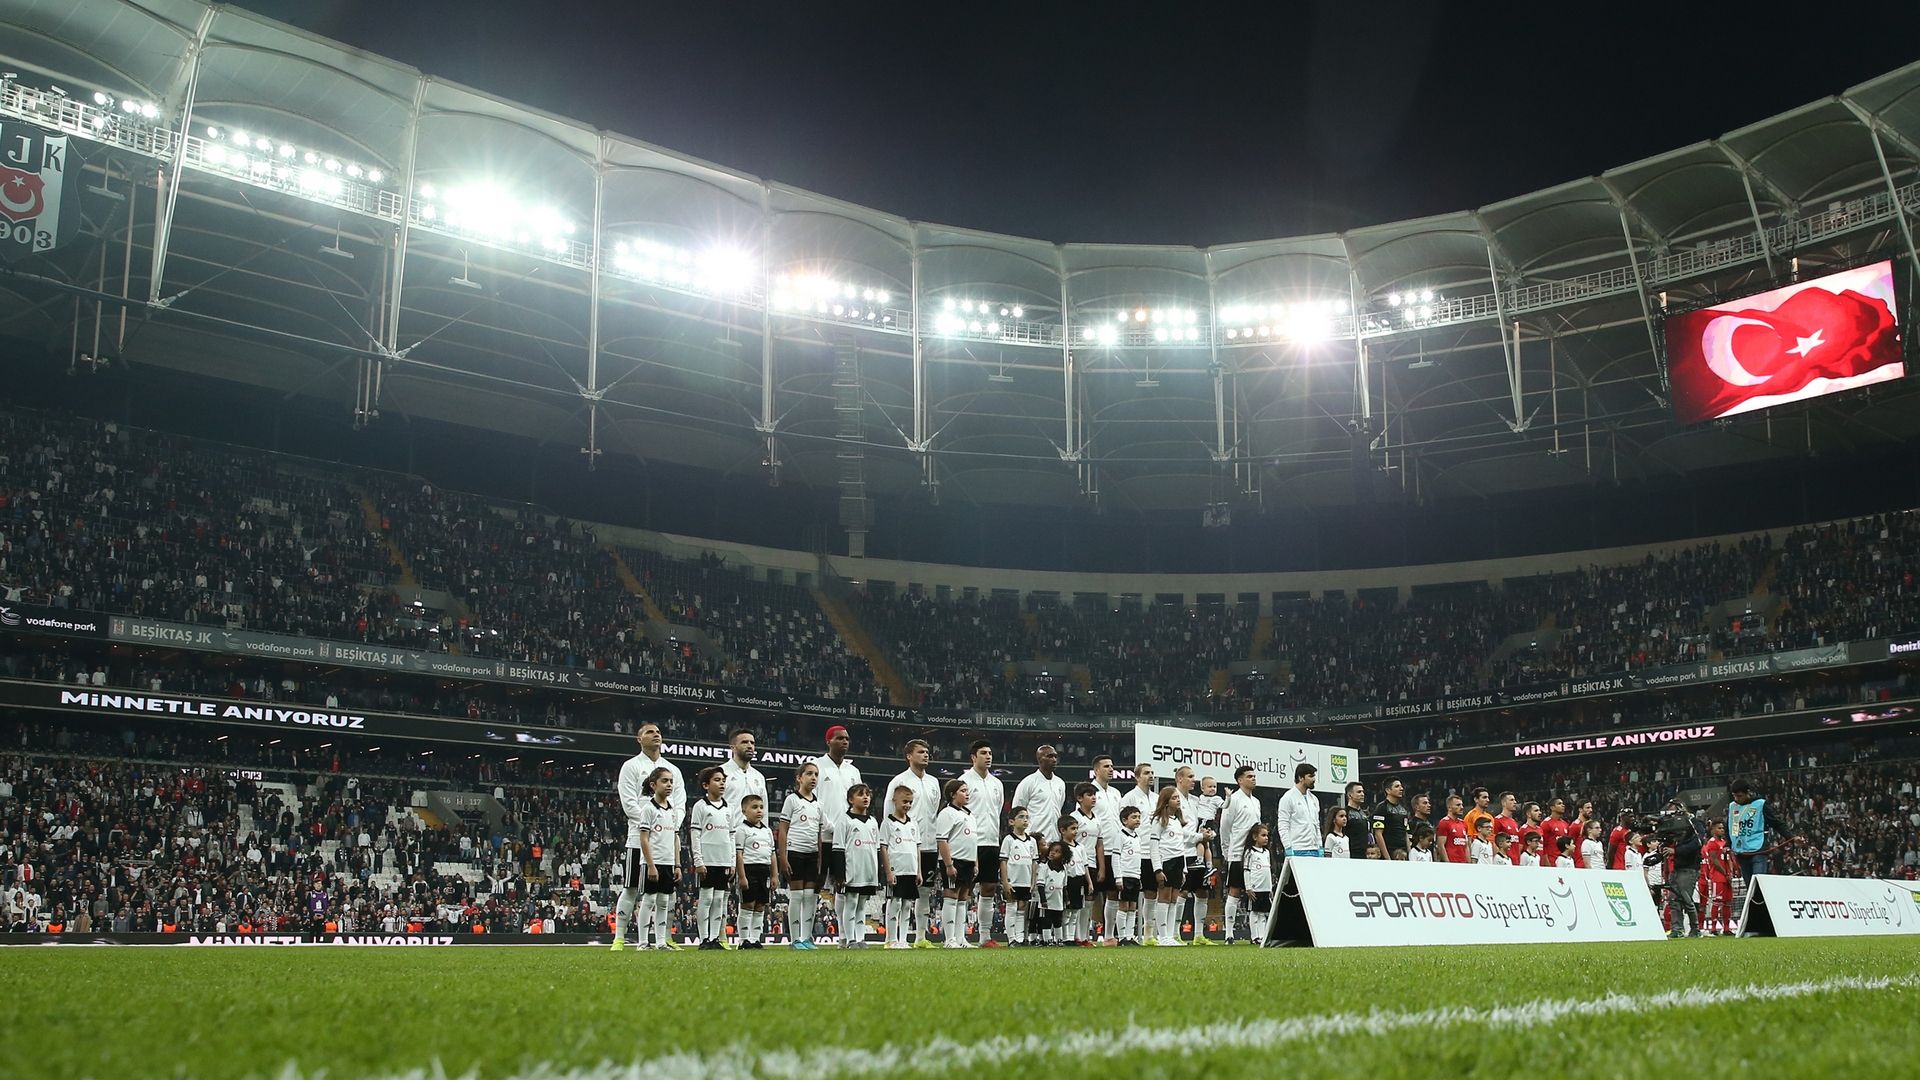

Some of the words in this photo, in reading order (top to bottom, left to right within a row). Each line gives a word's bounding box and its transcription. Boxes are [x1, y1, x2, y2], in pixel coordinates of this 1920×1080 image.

[26, 616, 73, 630] vodafone
[74, 622, 97, 633] park
[132, 623, 193, 645] BEŞİKTAŞ
[196, 632, 212, 644] JK
[246, 641, 291, 655] vodafone
[293, 646, 315, 657] park
[335, 646, 388, 665] BEŞİKTAŞ
[390, 653, 404, 665] JK
[1791, 655, 1827, 667] vodafone
[1828, 651, 1847, 664] park
[432, 662, 471, 674] vodafone
[472, 666, 491, 677] park
[509, 666, 555, 683] BEŞİKTAŞ
[557, 672, 570, 683] JK
[1712, 661, 1755, 676] BEŞİKTAŞ
[1757, 660, 1770, 671] JK
[1572, 680, 1611, 694] BEŞİKTAŞ
[1611, 678, 1623, 689] JK
[1646, 675, 1678, 685] vodafone
[1679, 672, 1697, 683] park
[594, 680, 629, 691] vodafone
[630, 683, 647, 694] park
[662, 683, 703, 699] BEŞİKTAŞ
[705, 689, 716, 699] JK
[737, 696, 767, 706] vodafone
[768, 699, 783, 709] park
[1446, 697, 1482, 709] BEŞİKTAŞ
[1483, 695, 1493, 705] JK
[1513, 692, 1542, 702] vodafone
[1543, 690, 1558, 700] park
[221, 705, 365, 729] ANIYORUZ
[803, 703, 831, 713] vodafone
[832, 706, 847, 716] park
[860, 705, 895, 720] BEŞİKTAŞ
[897, 709, 907, 719] JK
[1328, 713, 1358, 722] vodafone
[1358, 711, 1373, 721] park
[1385, 704, 1421, 717] BEŞİKTAŞ
[1422, 702, 1432, 712] JK
[927, 715, 957, 725] vodafone
[958, 717, 973, 726] park
[986, 715, 1025, 728] BEŞİKTAŞ
[1026, 719, 1037, 728] JK
[1057, 721, 1089, 729] vodafone
[1090, 722, 1105, 731] park
[1195, 719, 1226, 729] vodafone
[1227, 720, 1242, 729] park
[1256, 714, 1294, 726] BEŞİKTAŞ
[1296, 714, 1306, 723] JK
[1611, 725, 1715, 747] ANIYORUZ
[1152, 744, 1231, 768] SPORTOTO
[1349, 891, 1473, 919] SPORTOTO
[1475, 893, 1555, 929] SüperLig
[1788, 900, 1850, 919] SPORTOTO
[1848, 901, 1891, 926] SüperLig
